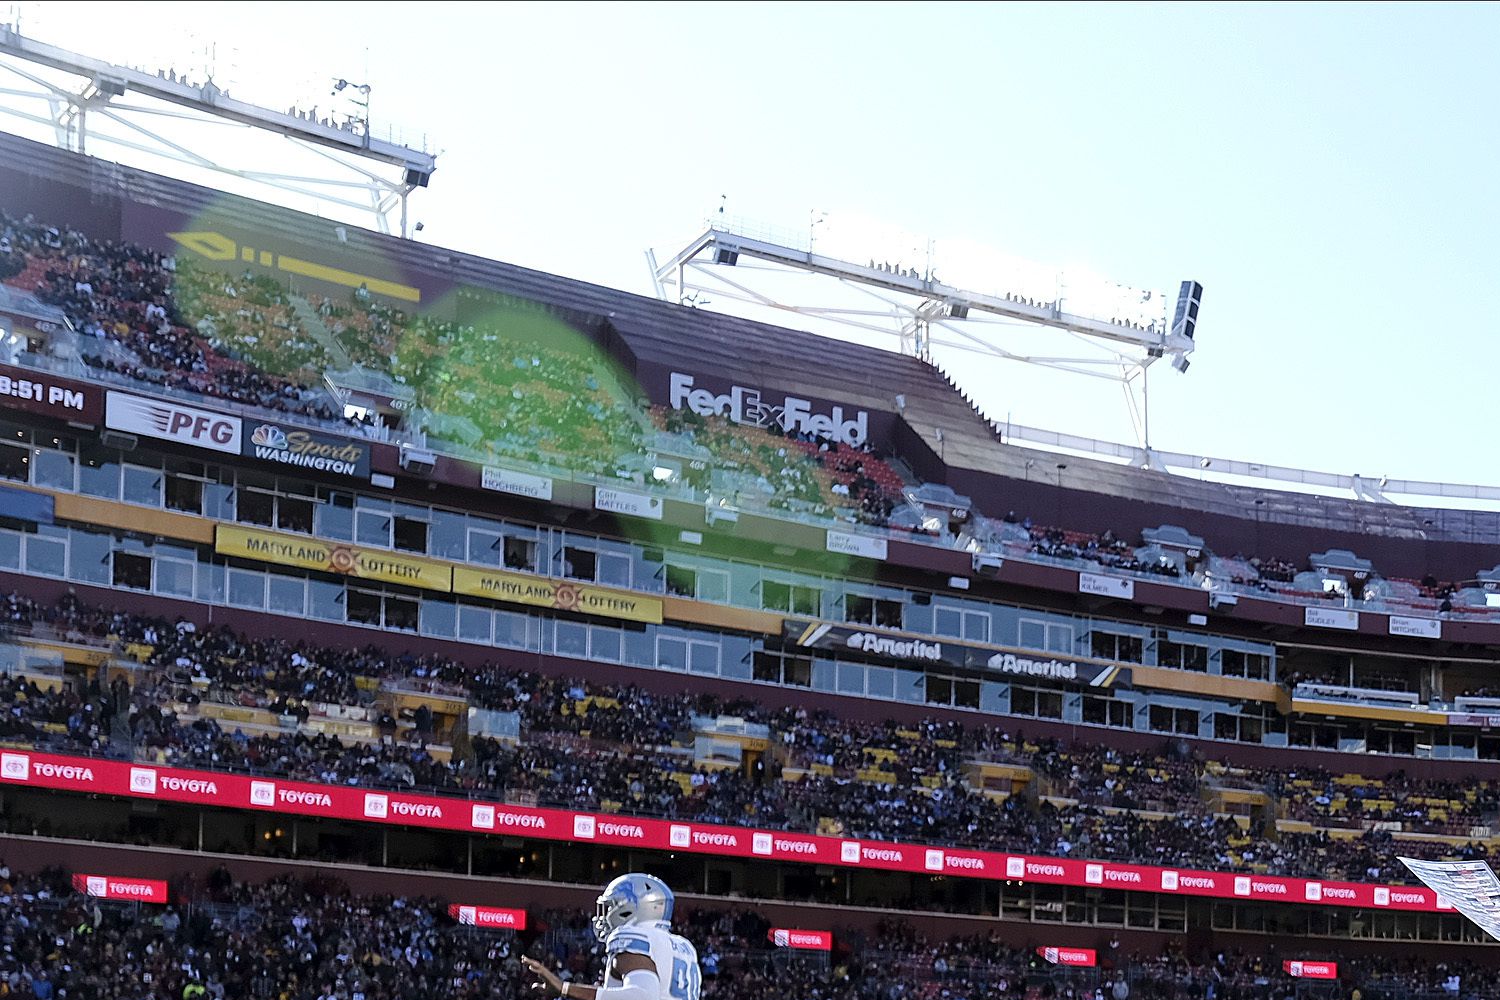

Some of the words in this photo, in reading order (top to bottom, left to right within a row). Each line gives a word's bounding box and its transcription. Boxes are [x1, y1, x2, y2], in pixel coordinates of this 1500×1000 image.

[48, 386, 84, 411] PM
[169, 411, 233, 444] PFG
[288, 431, 363, 464] Sports
[255, 446, 356, 475] WASHINGTON
[247, 537, 326, 563] MARYLAND
[360, 559, 422, 579] LOTTERY
[480, 577, 551, 600] MARYLAND
[582, 594, 636, 613] LOTTERY
[33, 762, 94, 781] TOYOTA
[159, 776, 218, 795] TOYOTA
[278, 789, 332, 807] TOYOTA
[390, 801, 442, 818] TOYOTA
[497, 812, 546, 829] TOYOTA
[597, 822, 644, 838] TOYOTA
[692, 831, 737, 847] TOYOTA
[774, 839, 817, 854] TOYOTA
[861, 847, 903, 862] TOYOTA
[945, 856, 985, 869] TOYOTA
[1026, 863, 1065, 876] TOYOTA
[1104, 870, 1141, 883] TOYOTA
[1179, 876, 1215, 888] TOYOTA
[109, 882, 153, 896] TOYOTA
[1251, 882, 1287, 894] TOYOTA
[1319, 887, 1357, 899] TOYOTA
[1390, 892, 1425, 904] TOYOTA
[477, 911, 515, 924] TOYOTA
[787, 934, 822, 945] TOYOTA
[1059, 951, 1088, 962] TOYOTA
[1301, 965, 1329, 974] TOYOTA
